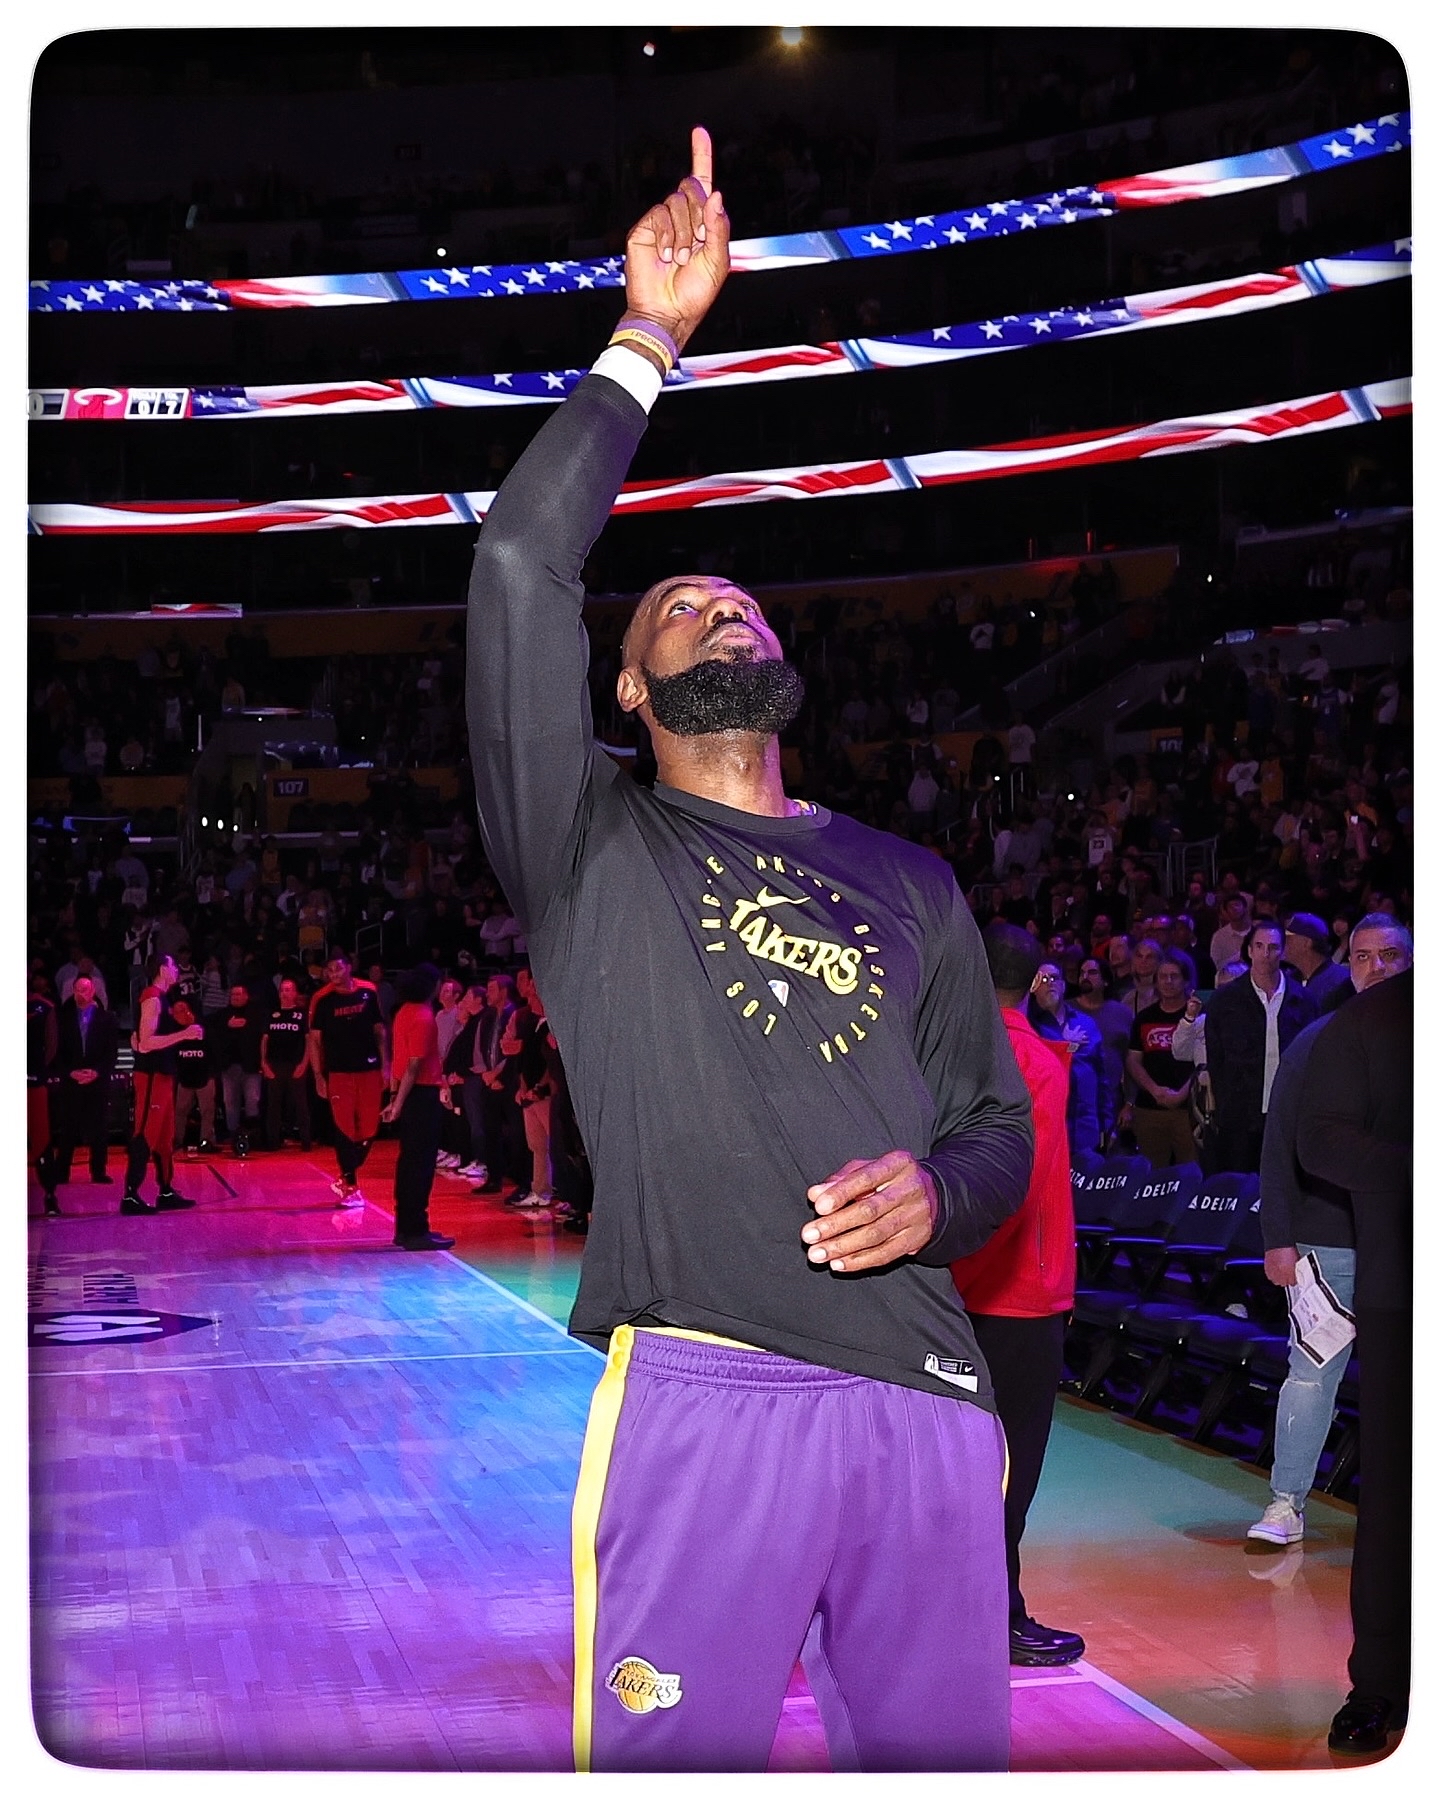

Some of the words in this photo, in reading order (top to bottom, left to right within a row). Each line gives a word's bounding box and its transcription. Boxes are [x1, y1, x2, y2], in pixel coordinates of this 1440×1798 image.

[138, 400, 150, 415] 0
[166, 400, 178, 415] 7
[278, 781, 304, 794] 107
[728, 898, 862, 995] LAKERS
[726, 981, 777, 1036] LOS
[269, 1022, 299, 1032] PHOTO
[1070, 1168, 1086, 1189] LTA
[1095, 1175, 1128, 1190] DELTA
[1142, 1180, 1181, 1198] DELTA
[1200, 1195, 1238, 1211] DELTA
[609, 1667, 680, 1704] LAKERS
